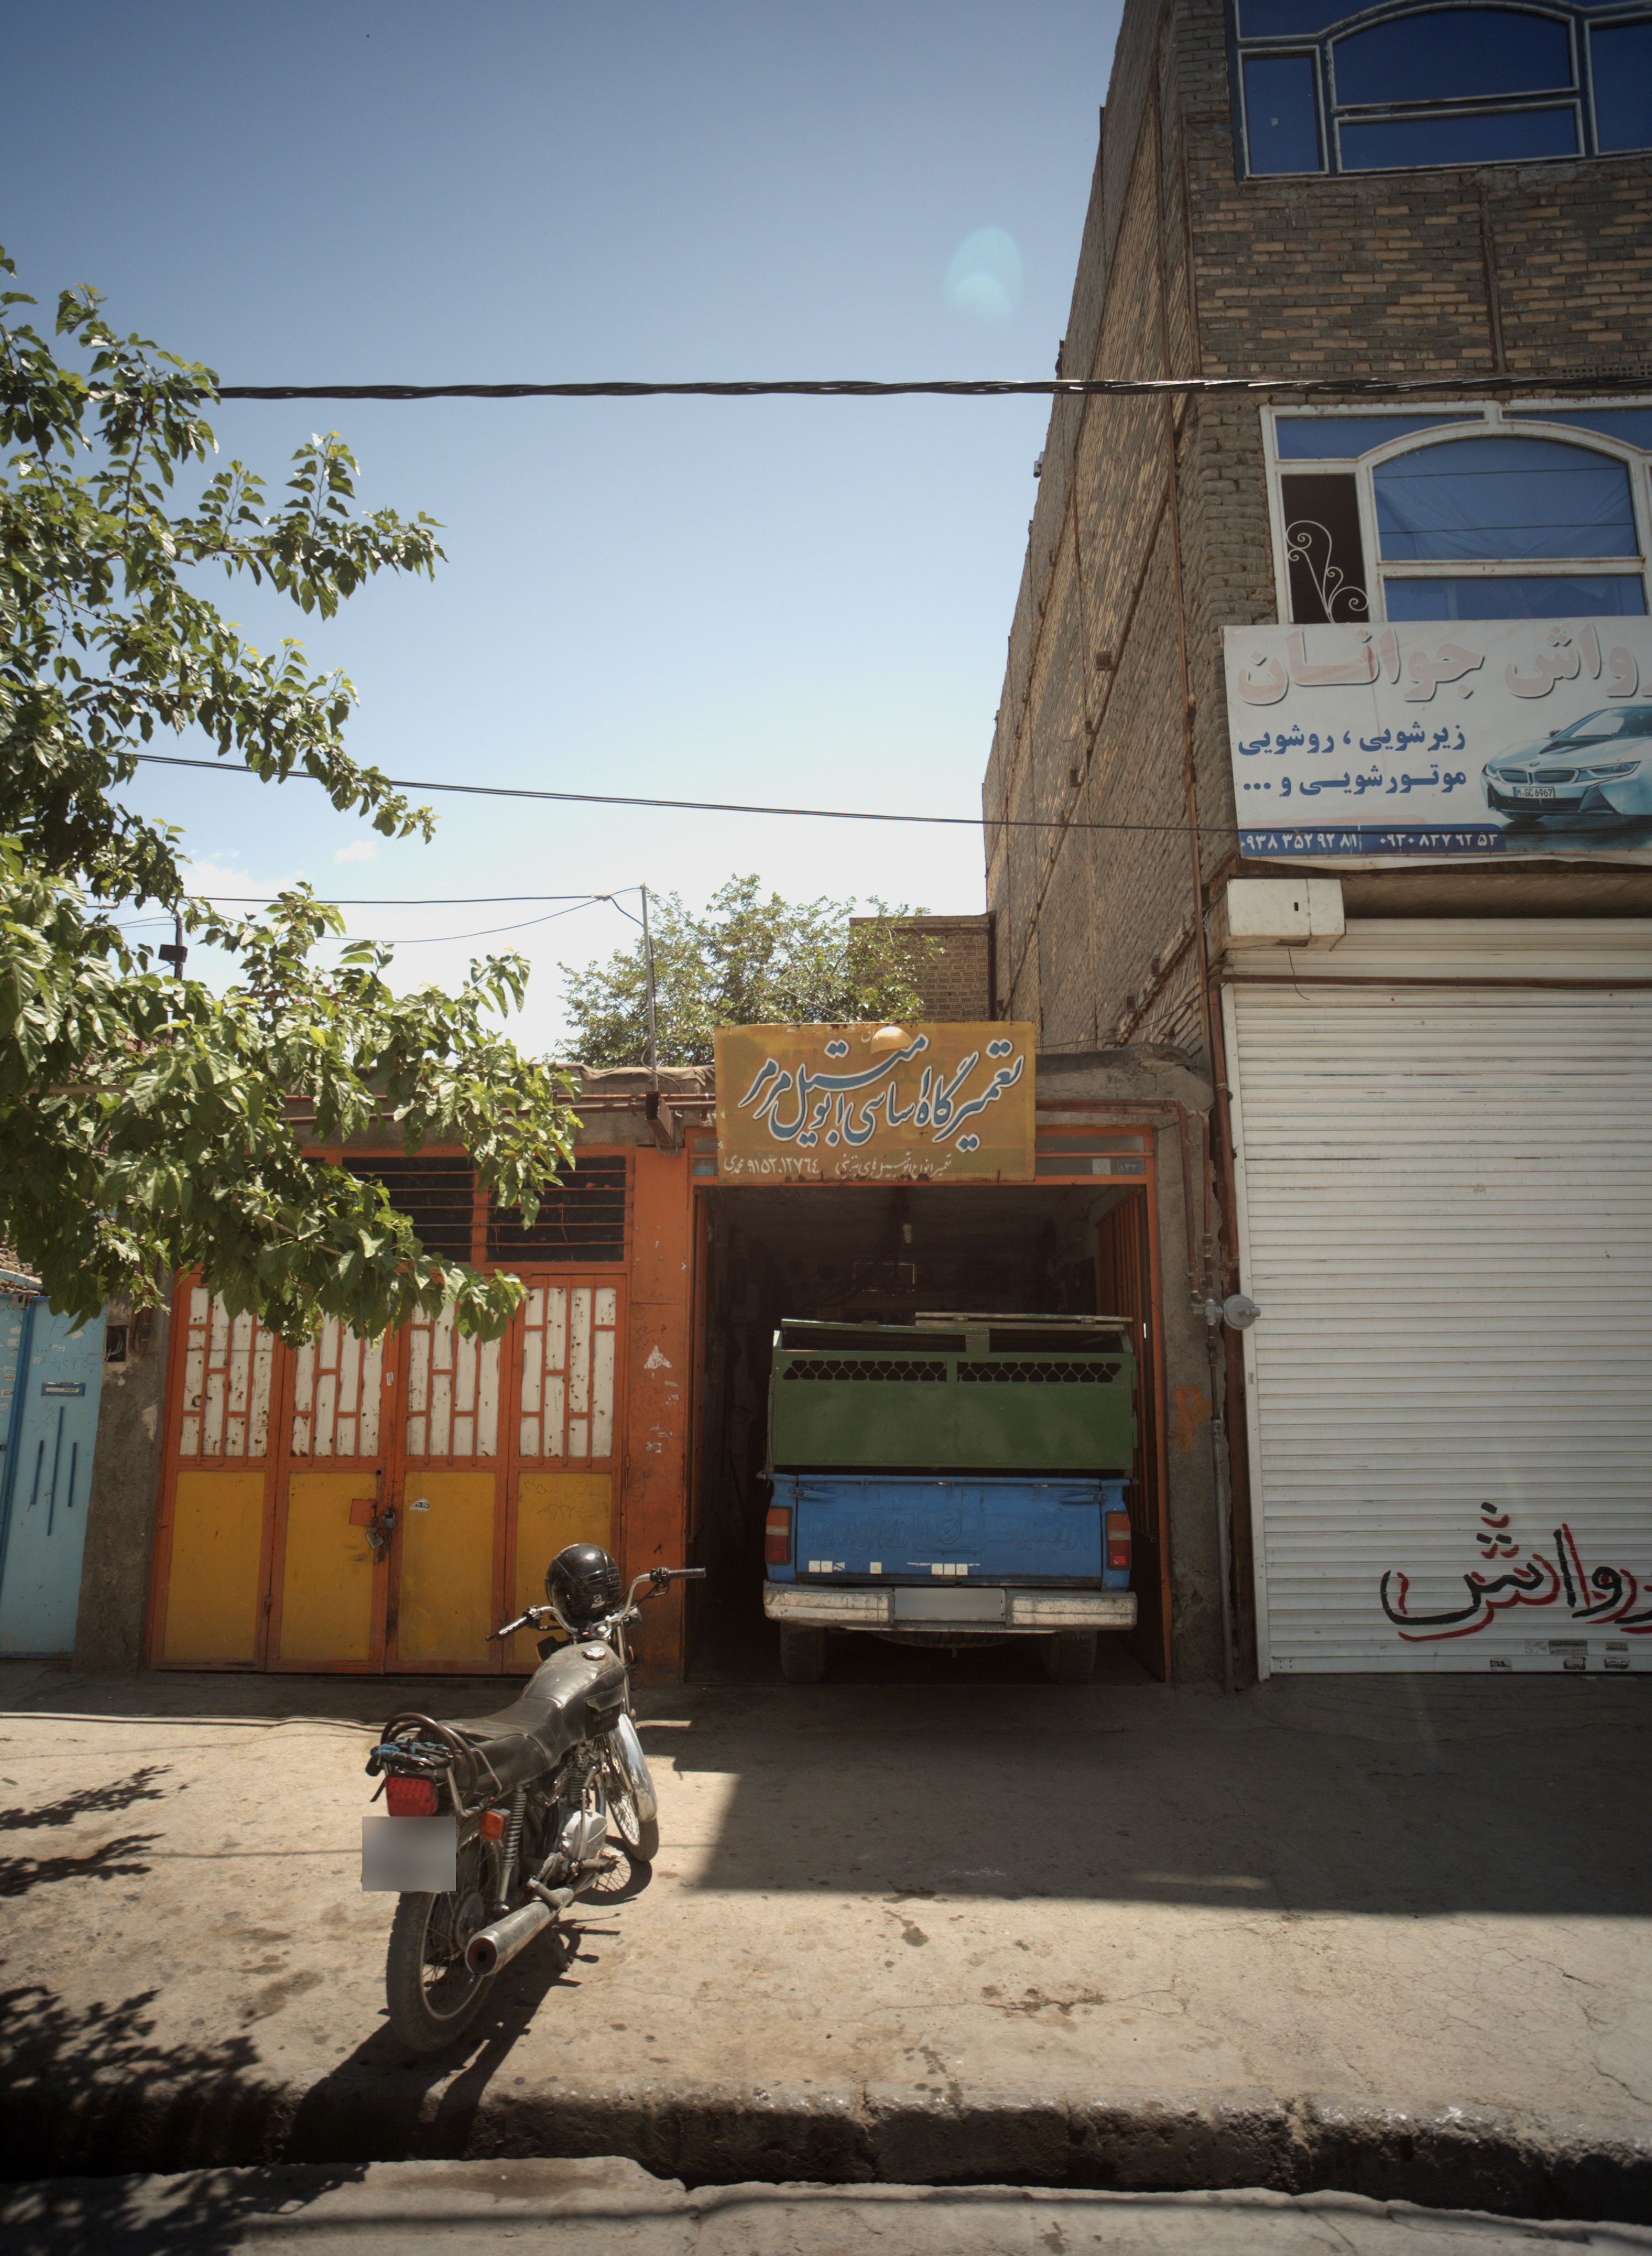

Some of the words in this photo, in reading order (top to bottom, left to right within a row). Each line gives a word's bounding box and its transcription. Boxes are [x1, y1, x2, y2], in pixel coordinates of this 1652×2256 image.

[1237, 627, 1485, 706] جوانان
[1504, 624, 1652, 701] واش
[1238, 724, 1335, 756] روشویی
[1359, 721, 1466, 752] زیرشویی
[1279, 776, 1292, 797] و
[1299, 764, 1467, 795] موتورشویی
[914, 1038, 1025, 1153] تعمیرگاه
[871, 1151, 912, 1179] اتومبیل
[911, 1158, 934, 1179] انواع
[929, 1153, 952, 1177] تعمیر
